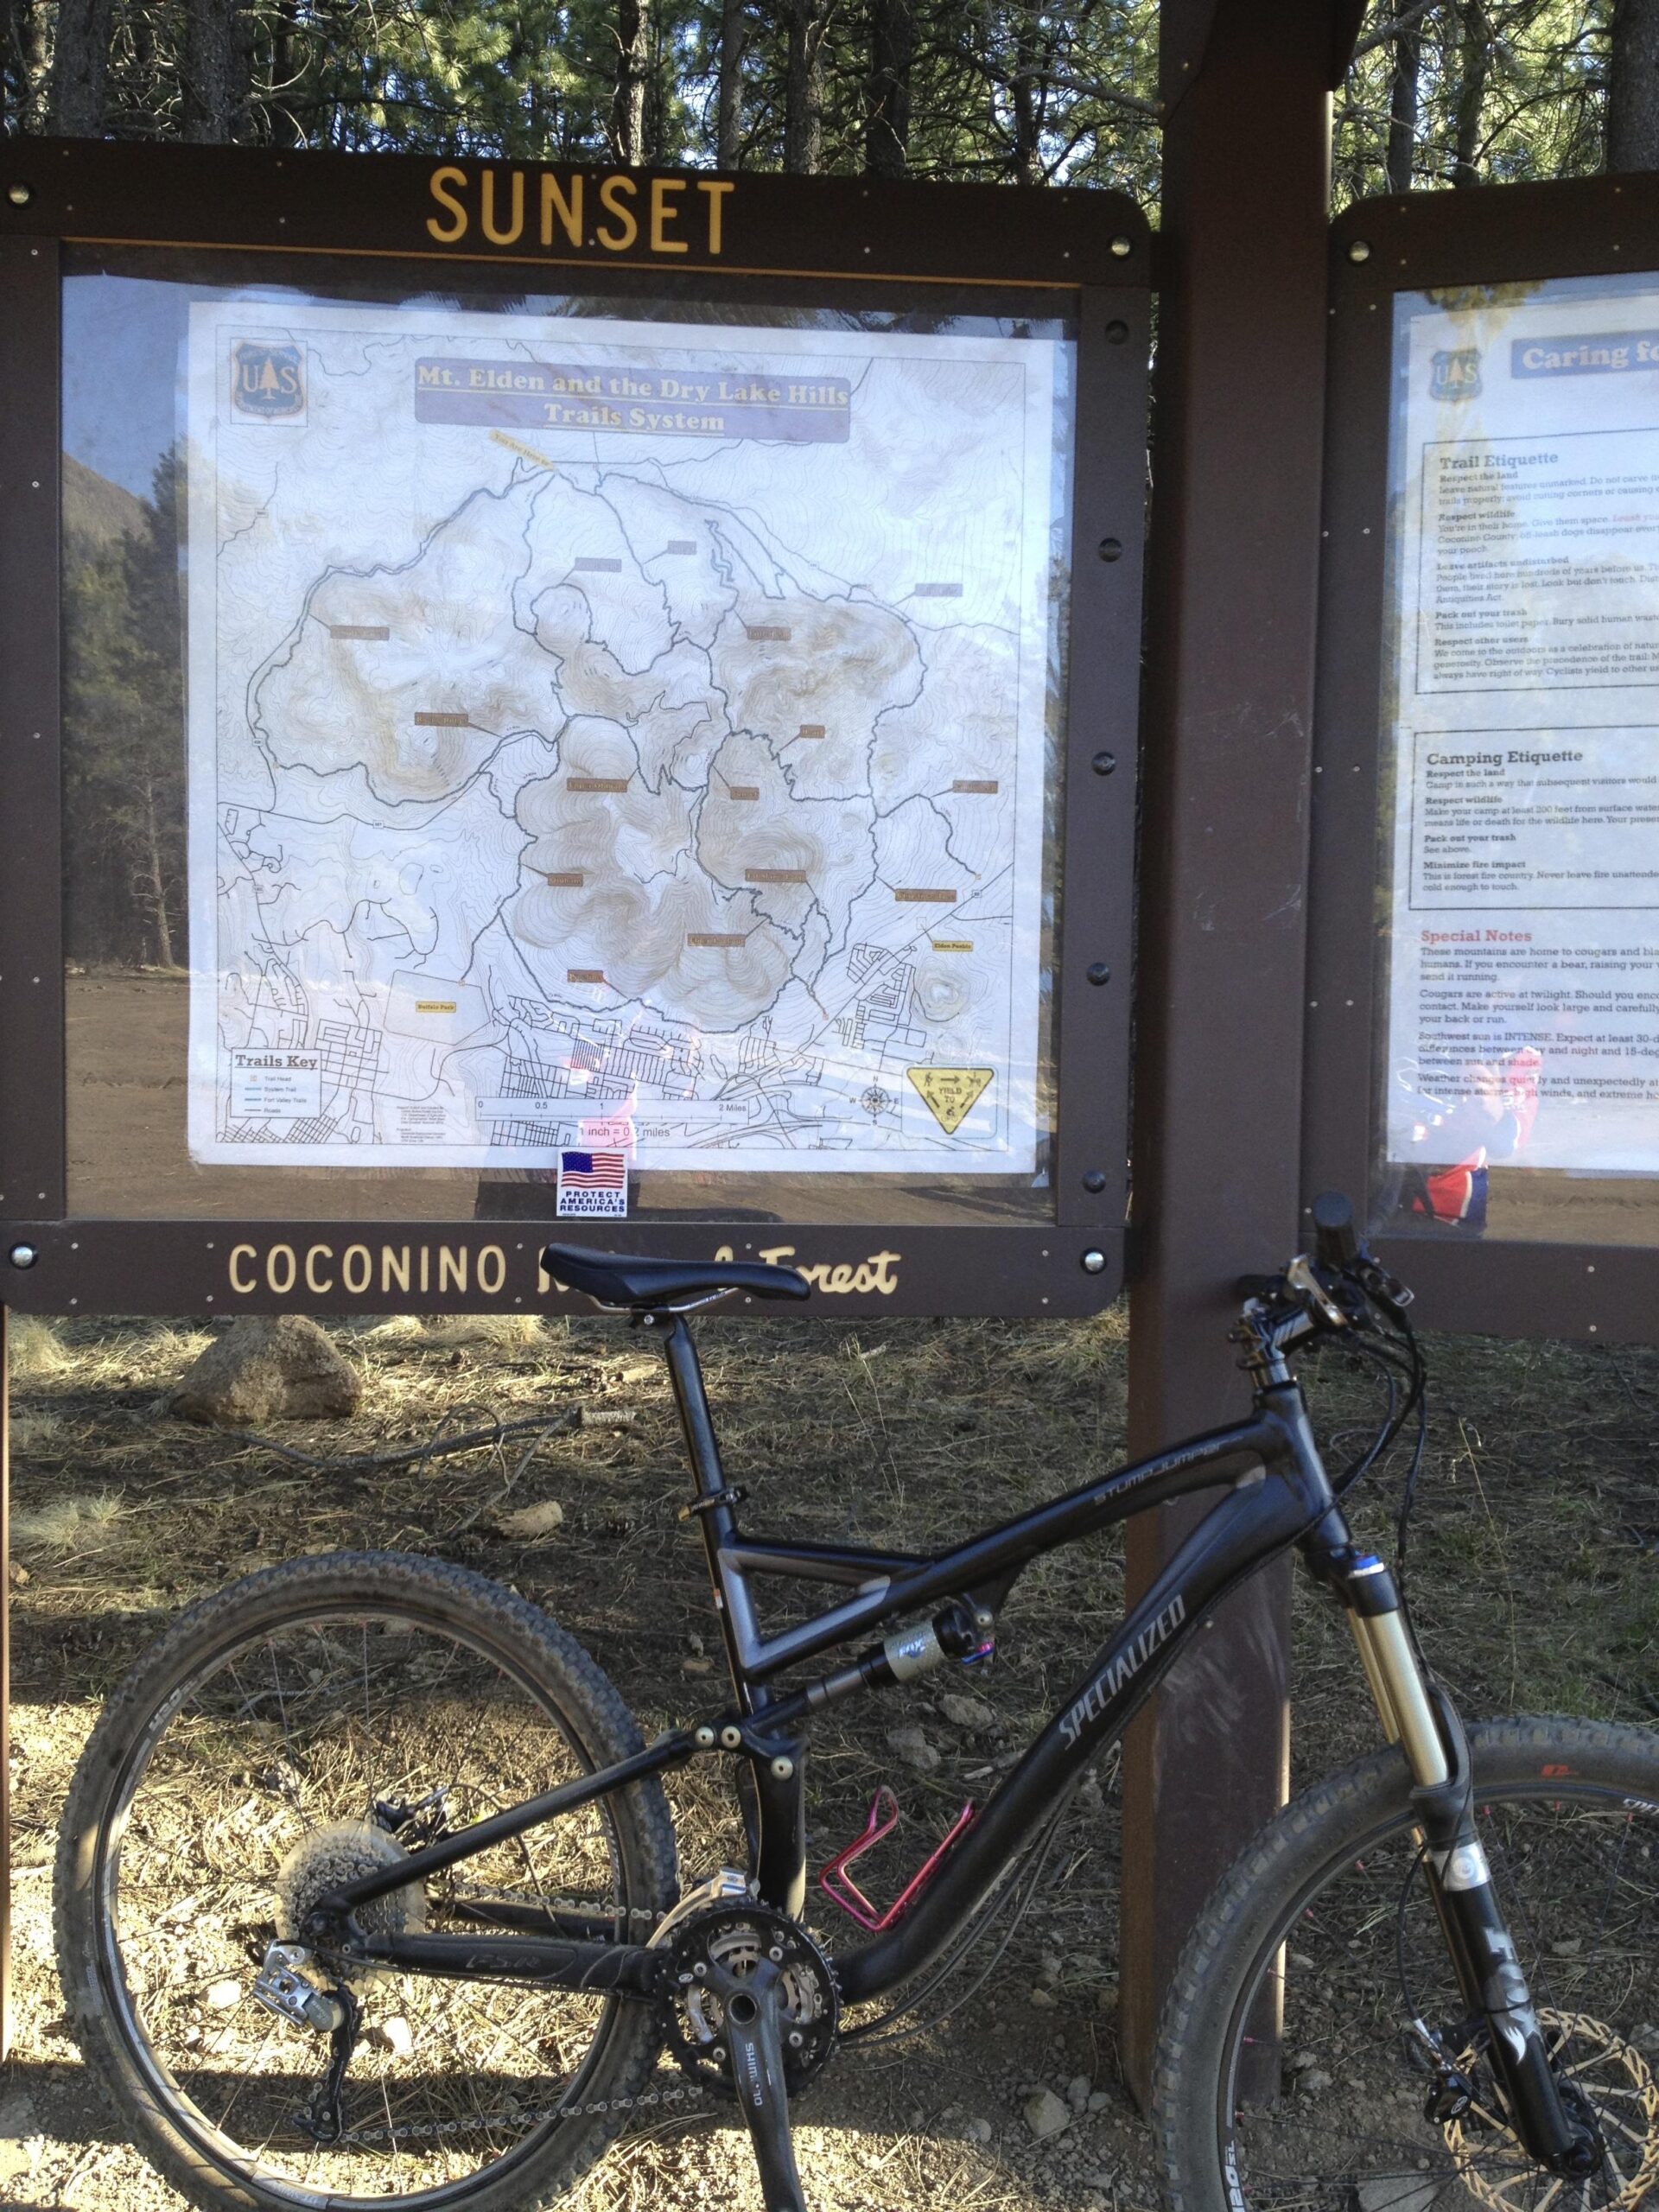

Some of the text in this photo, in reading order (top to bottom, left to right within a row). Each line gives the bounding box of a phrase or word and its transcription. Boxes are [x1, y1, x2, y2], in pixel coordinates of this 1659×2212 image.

[427, 167, 734, 253] SUNSET
[1522, 345, 1629, 369] Caring
[417, 366, 848, 405] Mt. Elden and the Dry Lake Hills
[544, 404, 724, 430] Trails System
[1440, 454, 1559, 469] Trail Etiquette
[1435, 638, 1472, 647] Respect
[1427, 750, 1583, 767] Camping Etiquette
[1427, 770, 1464, 779] Respect
[1426, 796, 1463, 805] Respect
[1491, 860, 1525, 869] impact
[1421, 931, 1532, 944] Special Notes
[1560, 961, 1587, 970] bear,
[1590, 962, 1626, 970] raising
[1630, 963, 1652, 971] your
[1420, 990, 1464, 1000] Cougars
[1492, 1003, 1535, 1013] yourself
[1563, 1003, 1590, 1013] large
[1557, 1034, 1593, 1044] Expect
[1571, 1046, 1599, 1056] night
[235, 1055, 318, 1071] Trails Key
[1573, 1077, 1645, 1088] unexpectedly
[643, 1128, 670, 1136] miles
[228, 1243, 507, 1295] COCONINO
[1059, 1594, 1186, 1751] SPECIALIZED
